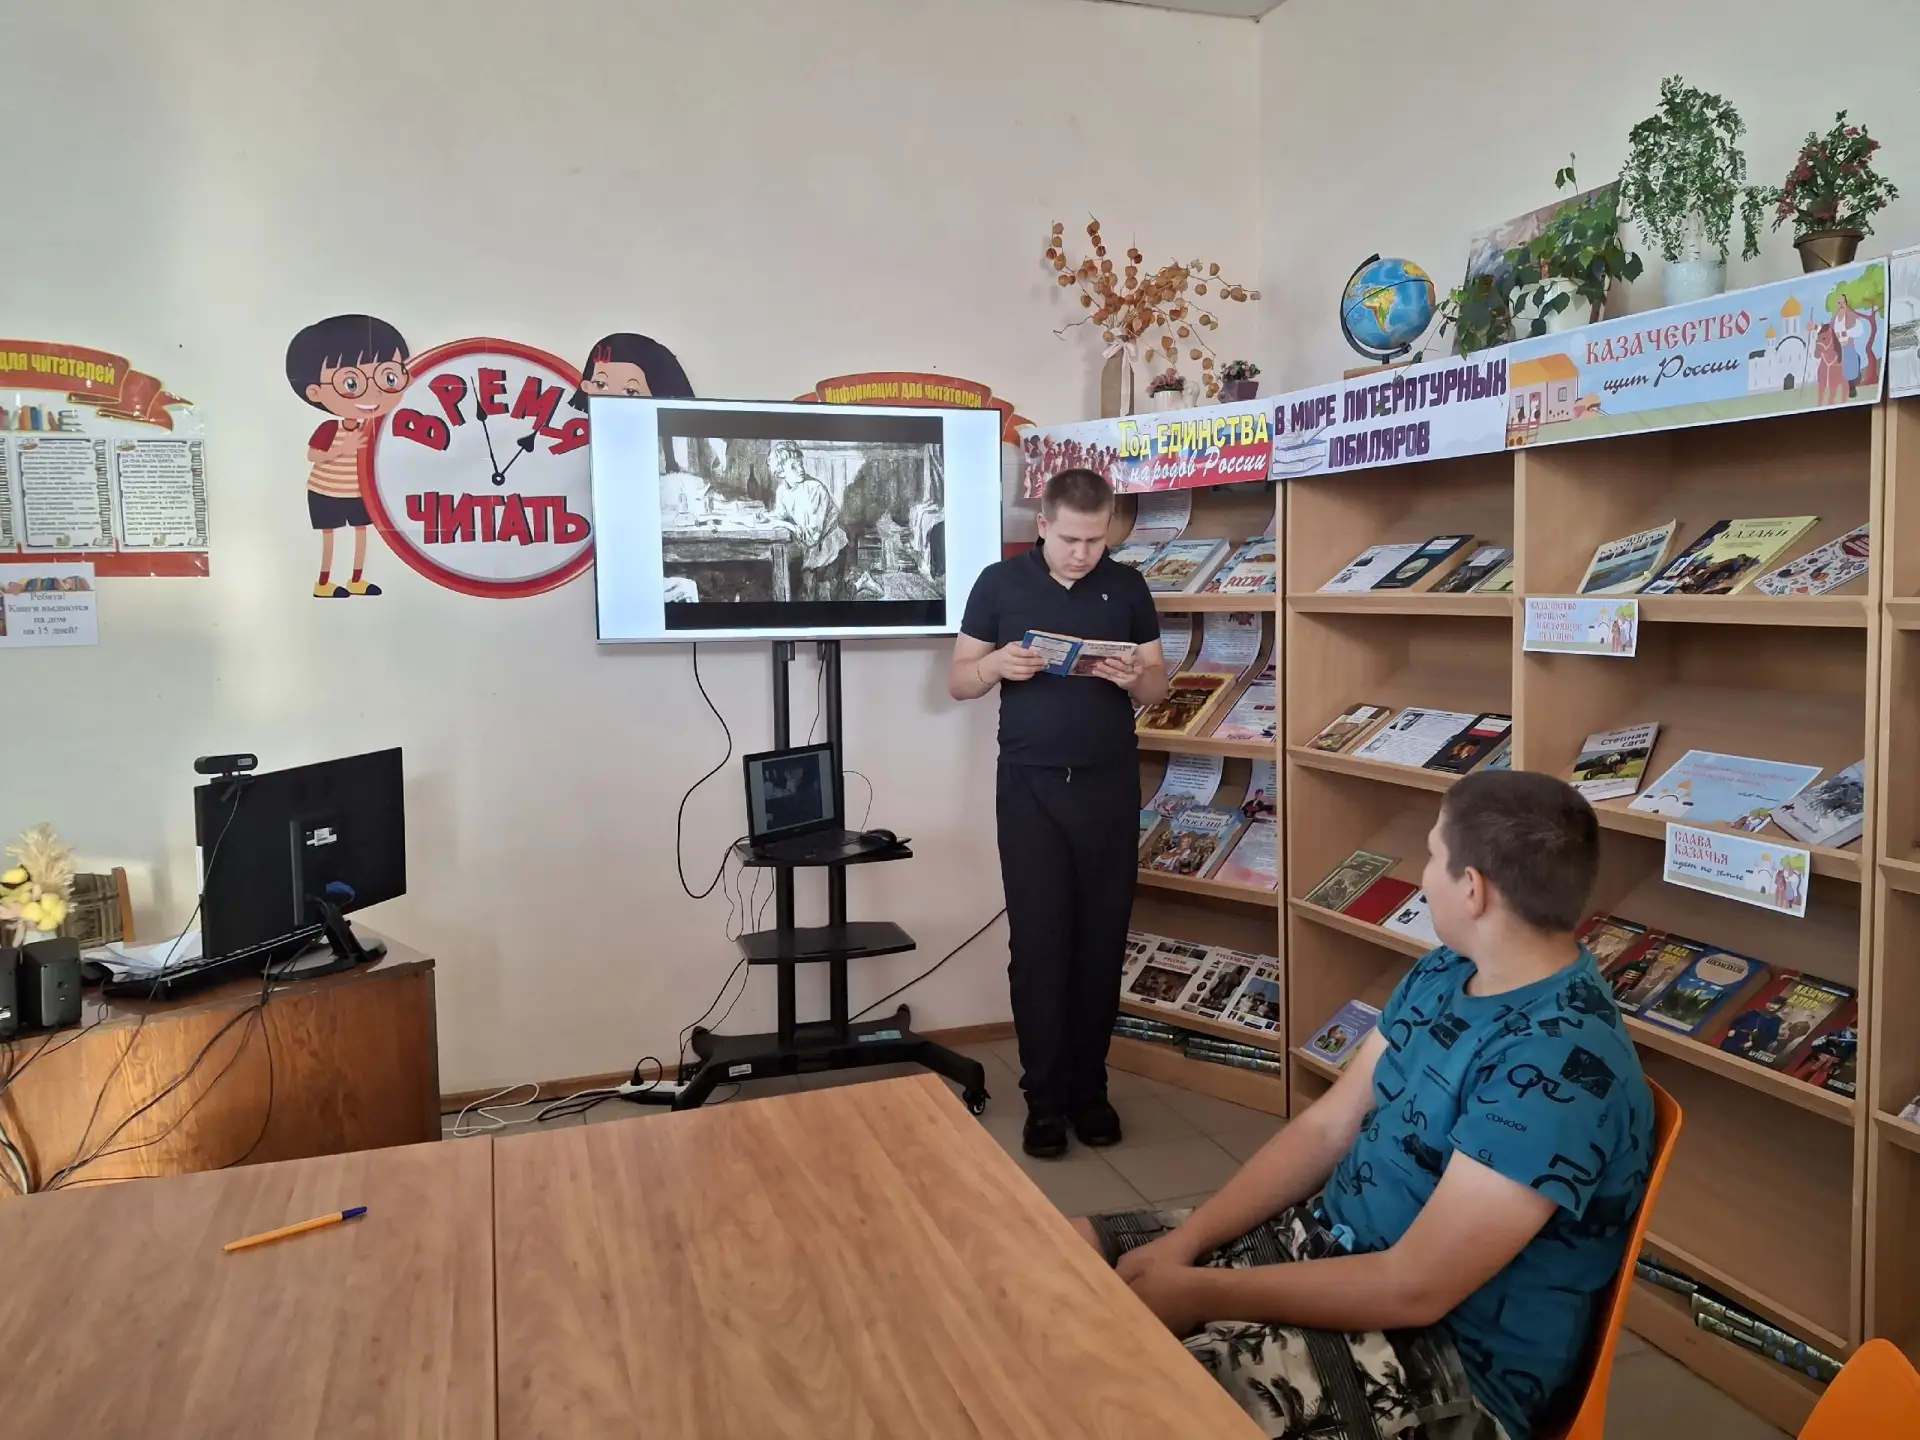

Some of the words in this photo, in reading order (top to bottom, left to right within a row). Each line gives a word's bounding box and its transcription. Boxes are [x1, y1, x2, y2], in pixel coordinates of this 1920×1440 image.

[1585, 310, 1751, 365] КАЗАЧЕСТВО
[31, 354, 115, 386] читателей
[1603, 373, 1649, 396] щит
[1654, 354, 1741, 389] России
[392, 367, 590, 456] ВРЕМЯ
[825, 382, 899, 404] Информация
[901, 382, 923, 401] для
[925, 384, 982, 408] читателей
[1274, 405, 1285, 436] В
[1291, 394, 1337, 433] МИРЕ
[1343, 358, 1507, 424] ЛИТЕРАТУРНЫХ
[1117, 420, 1151, 461] Год
[1157, 412, 1269, 455] ЕДИНСТВА
[1328, 420, 1430, 468] ЮБИЛЯРОВ
[1129, 454, 1197, 487] народов
[1203, 445, 1267, 478] России
[405, 492, 592, 546] ЧИТАТЬ
[38, 626, 49, 635] 15
[1600, 732, 1649, 746] Степная
[1621, 739, 1647, 748] сага
[1674, 830, 1712, 849] СЛАВА
[1674, 843, 1729, 866] КАЗАЧЬЯ
